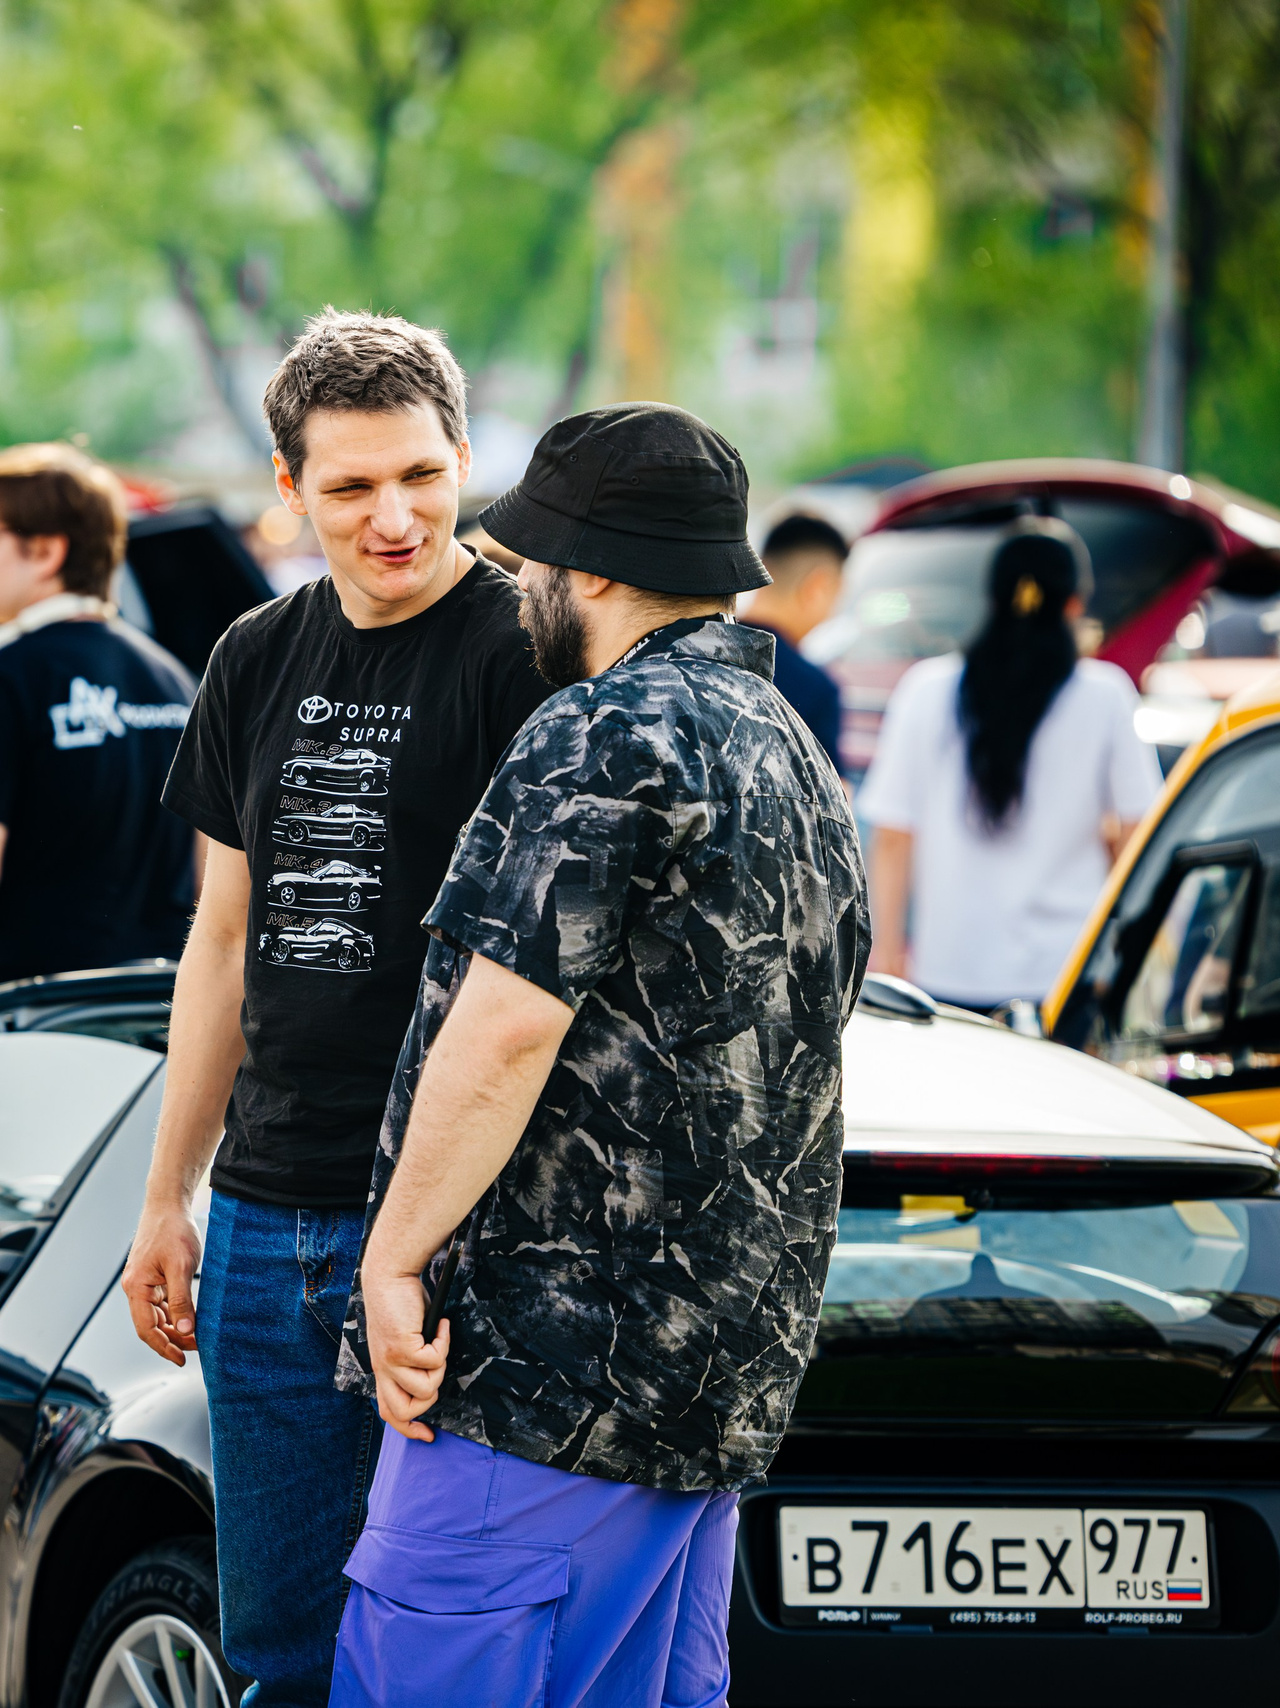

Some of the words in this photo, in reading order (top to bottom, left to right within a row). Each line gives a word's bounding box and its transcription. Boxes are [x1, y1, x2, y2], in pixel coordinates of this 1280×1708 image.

[333, 702, 412, 720] TOYOTA
[339, 727, 401, 743] SUPRA
[291, 738, 343, 757] MK.2
[280, 795, 332, 814] MK.3
[274, 852, 323, 870] MK.4
[266, 911, 316, 929] MK.5
[1088, 1518, 1185, 1575] 977
[1116, 1580, 1164, 1600] RUS
